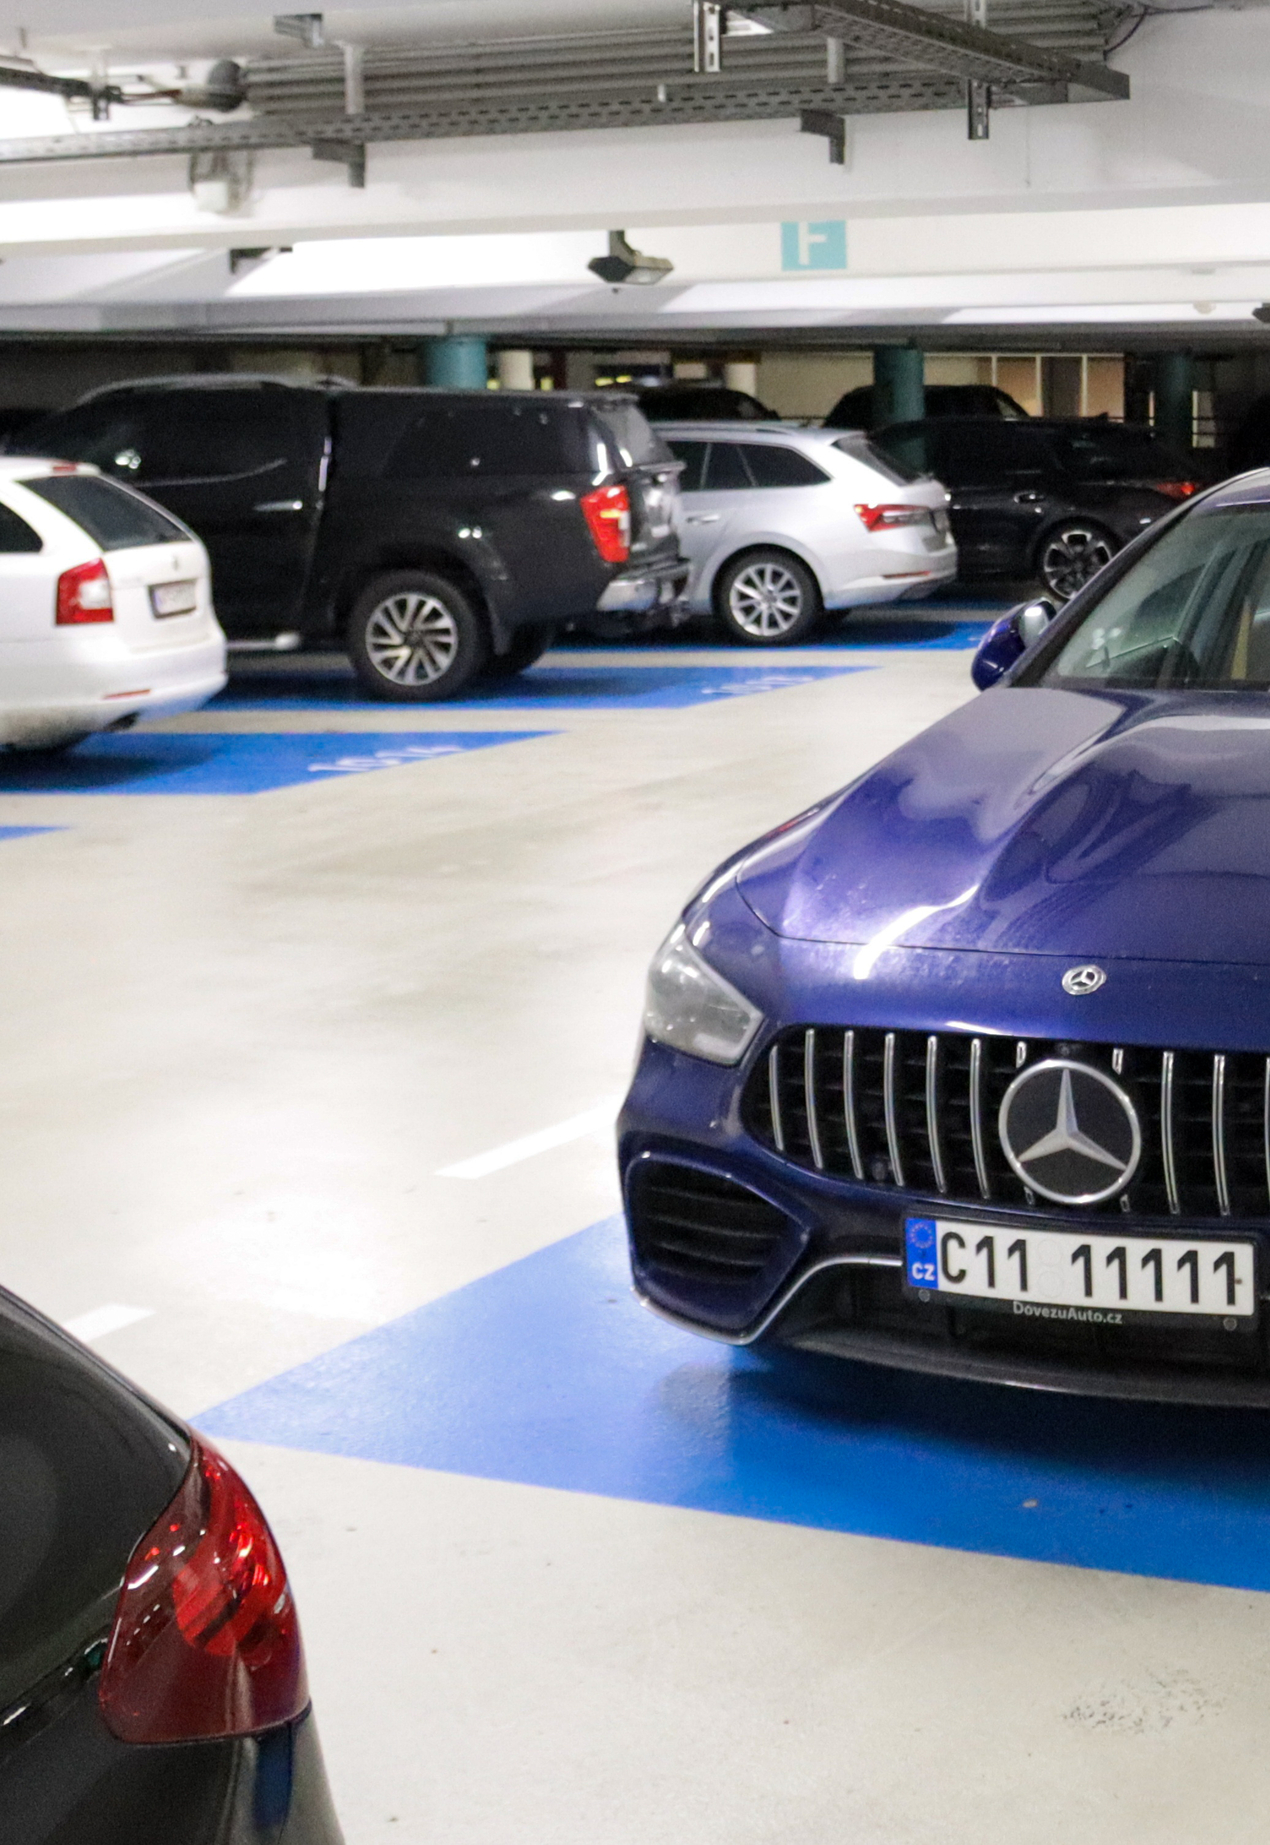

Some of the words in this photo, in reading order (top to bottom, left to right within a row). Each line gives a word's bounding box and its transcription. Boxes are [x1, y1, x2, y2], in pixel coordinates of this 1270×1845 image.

[911, 1261, 936, 1282] CZ
[940, 1231, 1029, 1293] C11
[1070, 1243, 1238, 1307] 11111
[1012, 1299, 1124, 1325] DovezuAuto.cz
